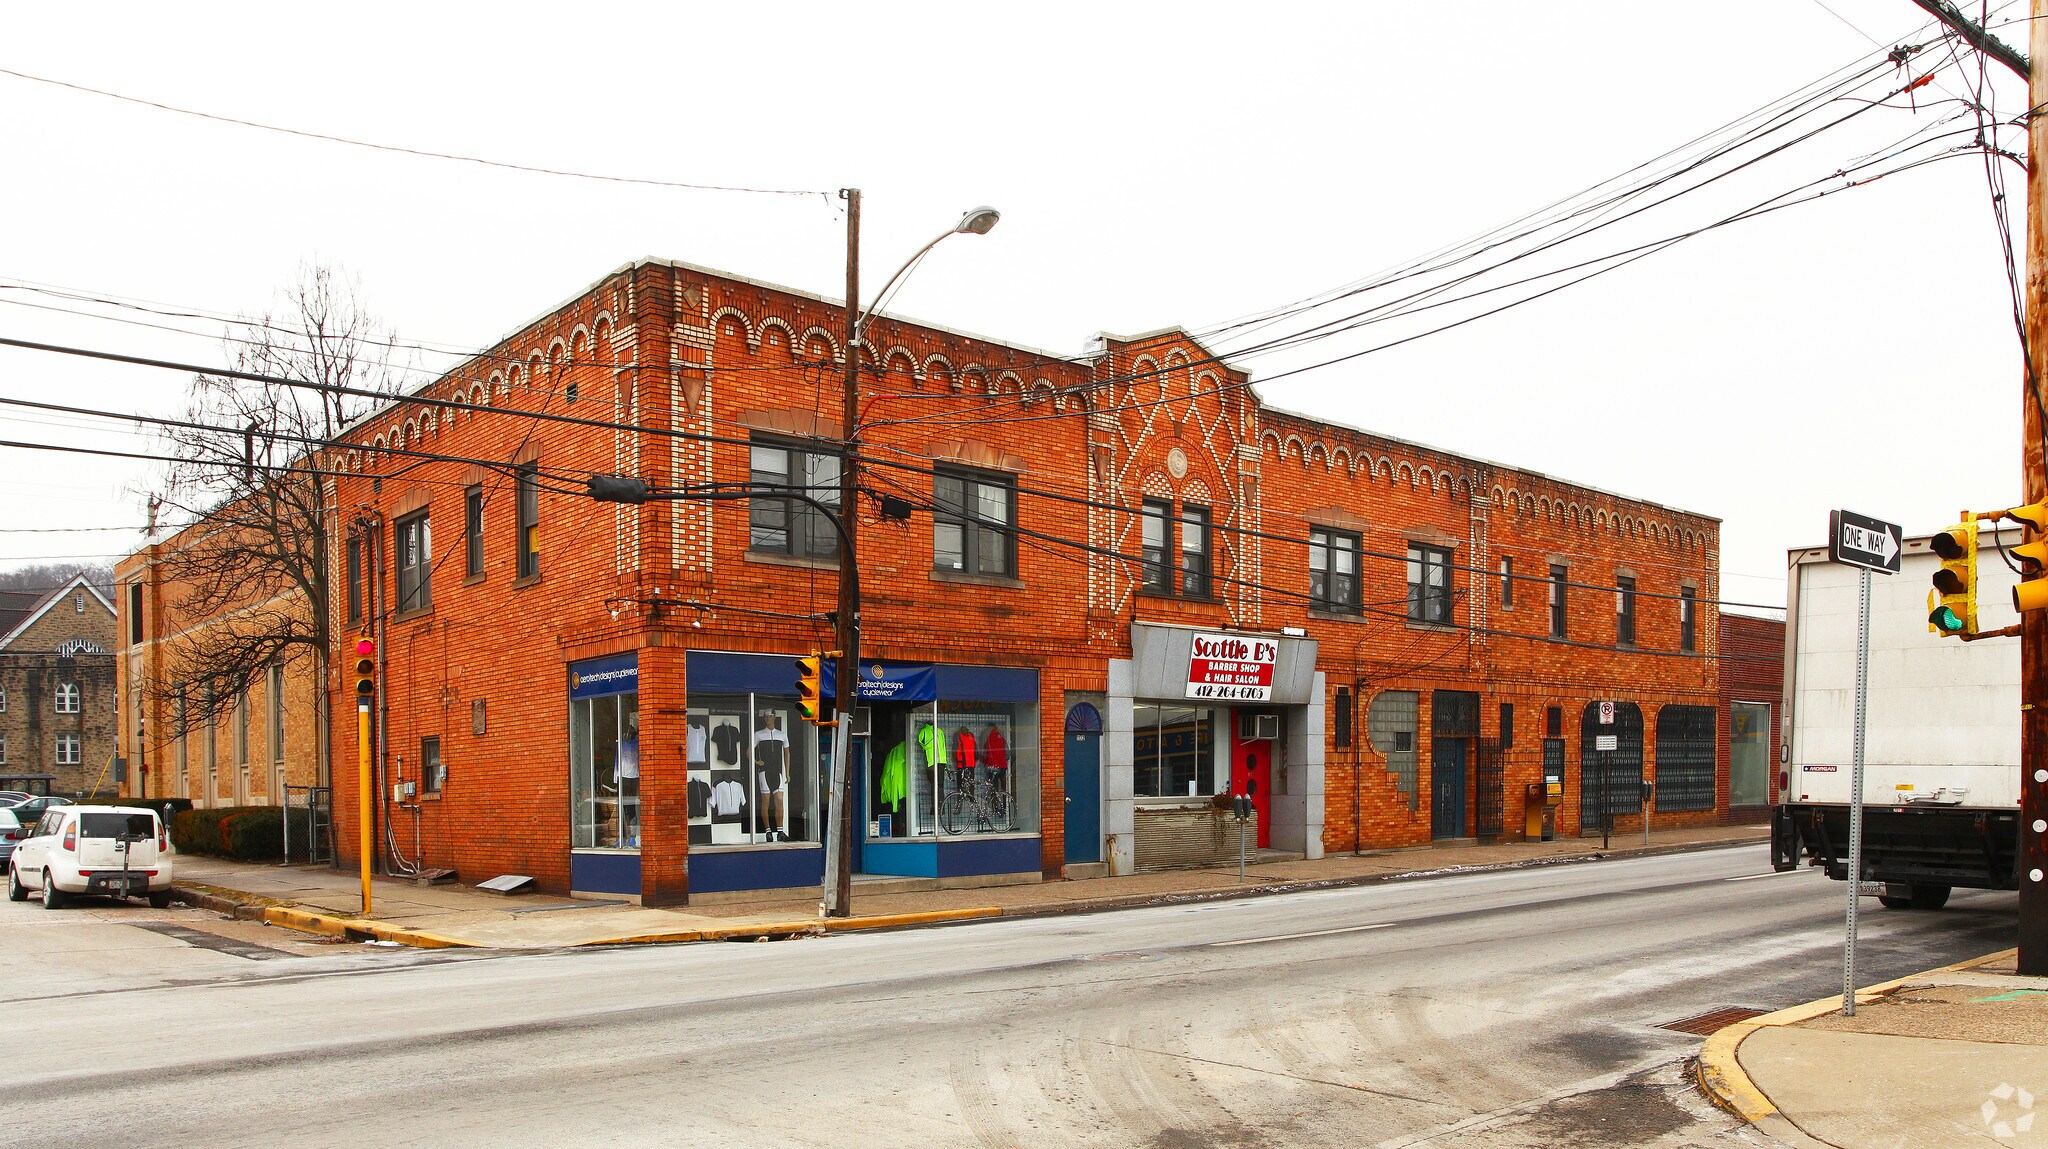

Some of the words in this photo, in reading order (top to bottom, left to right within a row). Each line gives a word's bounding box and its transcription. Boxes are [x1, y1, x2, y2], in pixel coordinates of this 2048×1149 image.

[1844, 526, 1862, 548] ONE
[1867, 532, 1886, 553] WAY
[1193, 637, 1248, 660] Scottie
[1253, 642, 1275, 662] B's
[1208, 661, 1238, 672] BARBER
[1240, 663, 1260, 673] SHOP
[1204, 672, 1211, 682] &
[1213, 673, 1233, 683] HAIR
[1234, 675, 1259, 684] SALON
[863, 689, 894, 697] cyclewear
[1195, 685, 1264, 699] 412-264-6705
